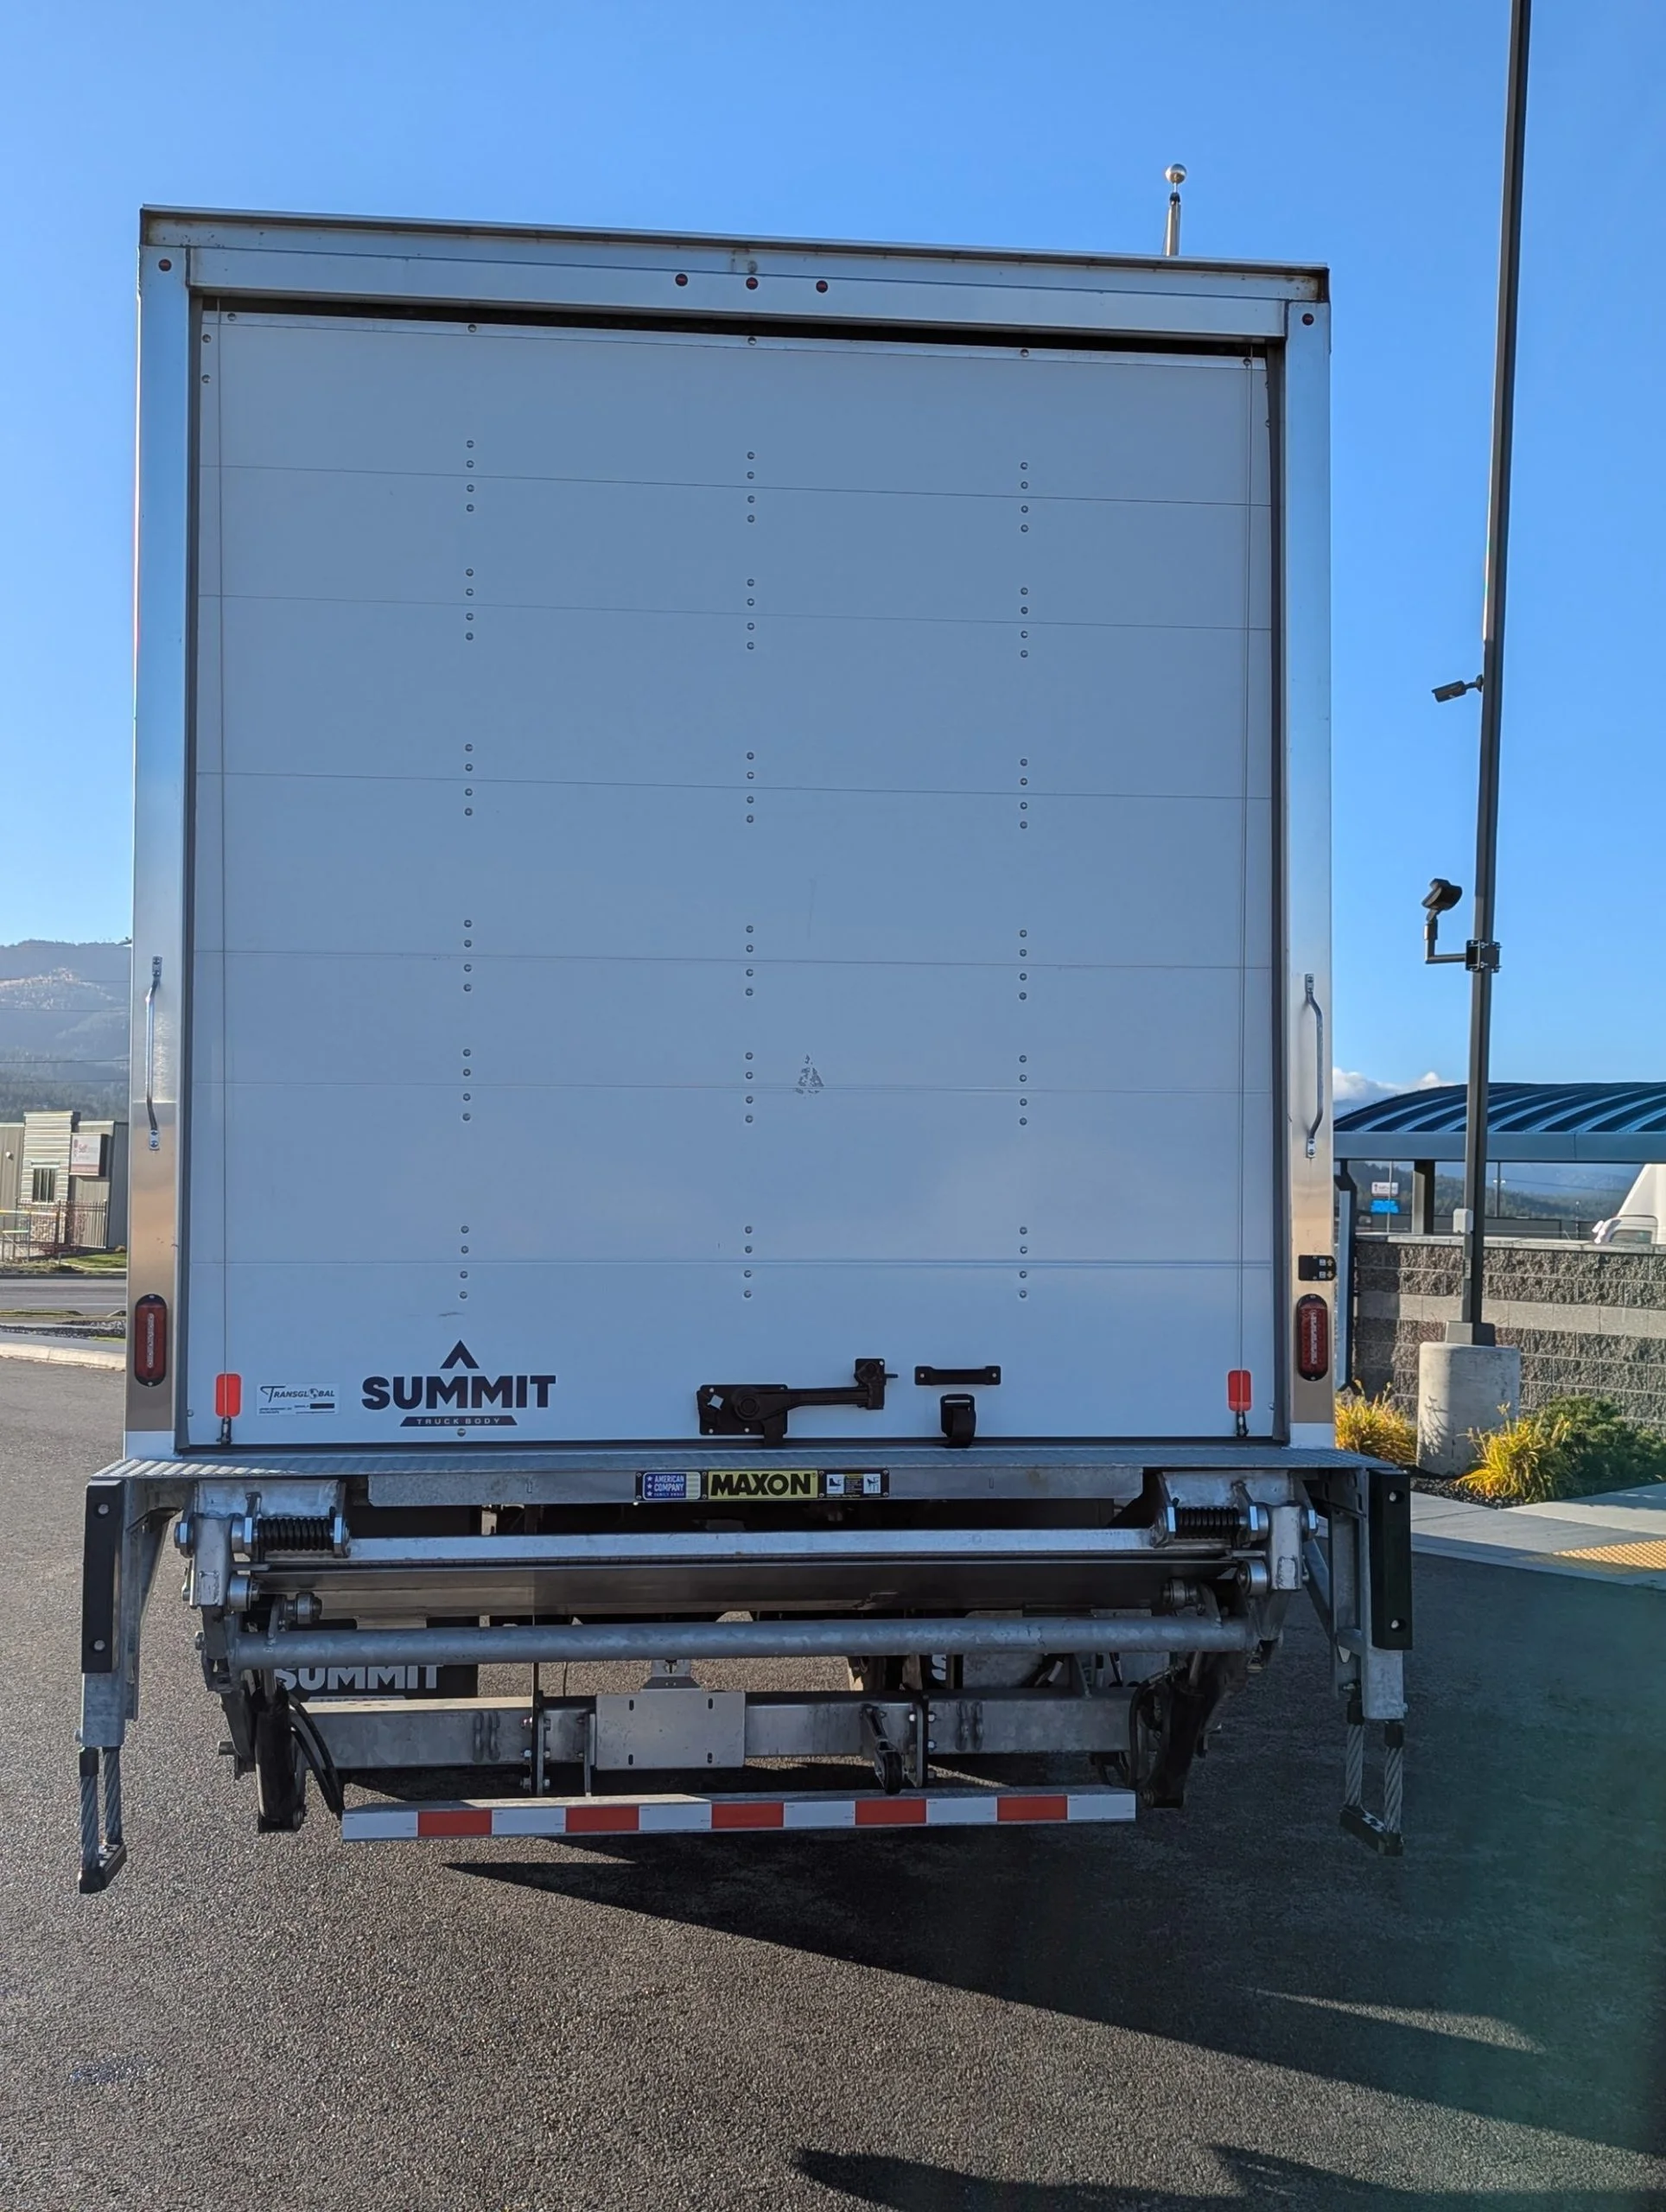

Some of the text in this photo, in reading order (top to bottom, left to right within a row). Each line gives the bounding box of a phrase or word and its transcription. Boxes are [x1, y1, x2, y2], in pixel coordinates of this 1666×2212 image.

[361, 1375, 556, 1410] SUMMIT
[465, 1417, 500, 1426] BODY
[653, 1483, 684, 1492] COMPANY
[710, 1473, 811, 1496] MAXON
[275, 1665, 444, 1690] SUMMIT
